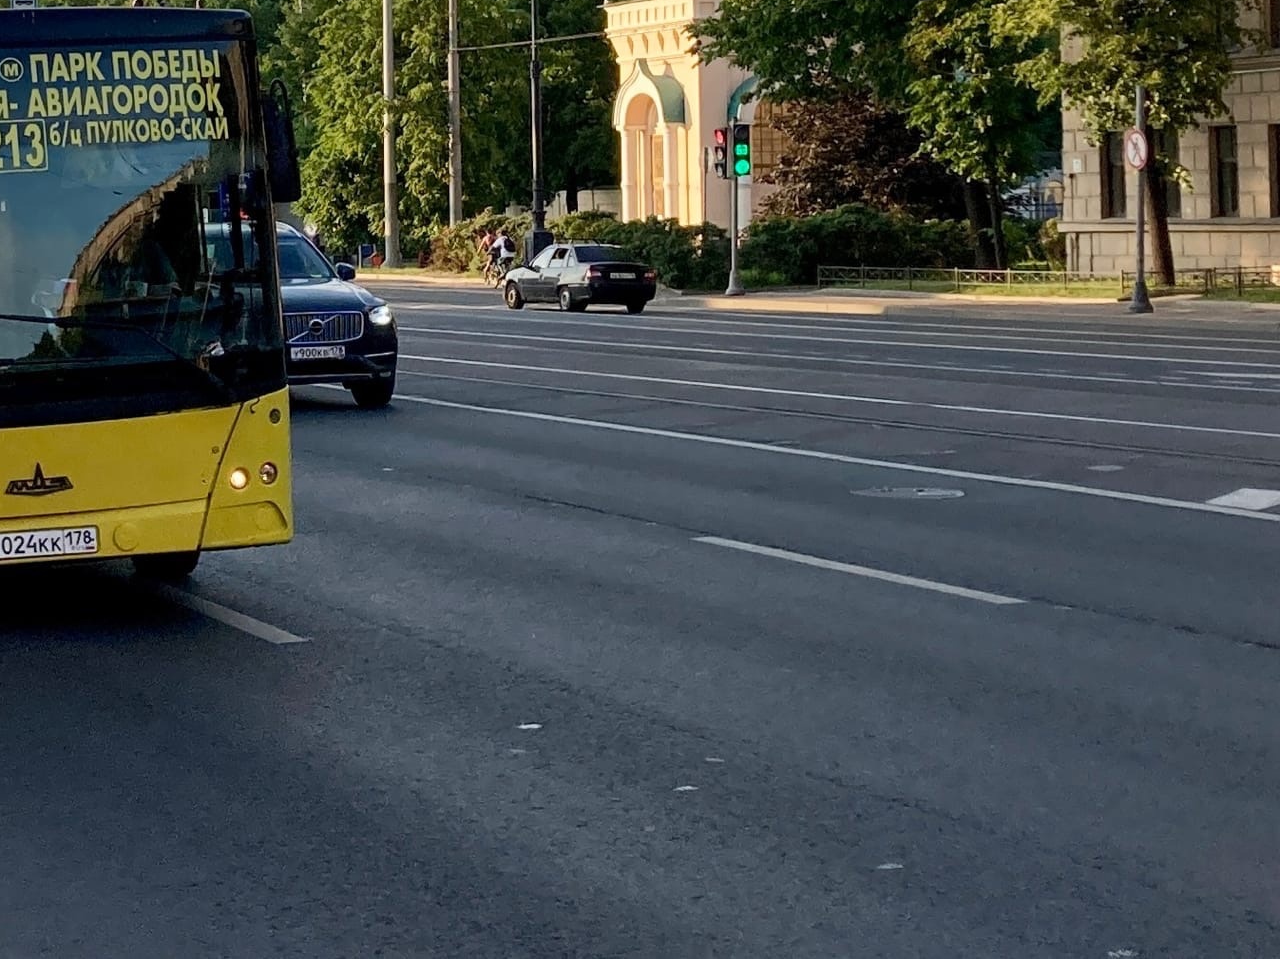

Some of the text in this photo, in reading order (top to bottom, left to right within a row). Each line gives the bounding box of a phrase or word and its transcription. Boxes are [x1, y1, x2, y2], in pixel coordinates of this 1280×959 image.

[29, 51, 105, 83] ПАРК
[111, 49, 221, 83] ПОБЕДЫ
[27, 82, 224, 118] АВИАГОРОДОК
